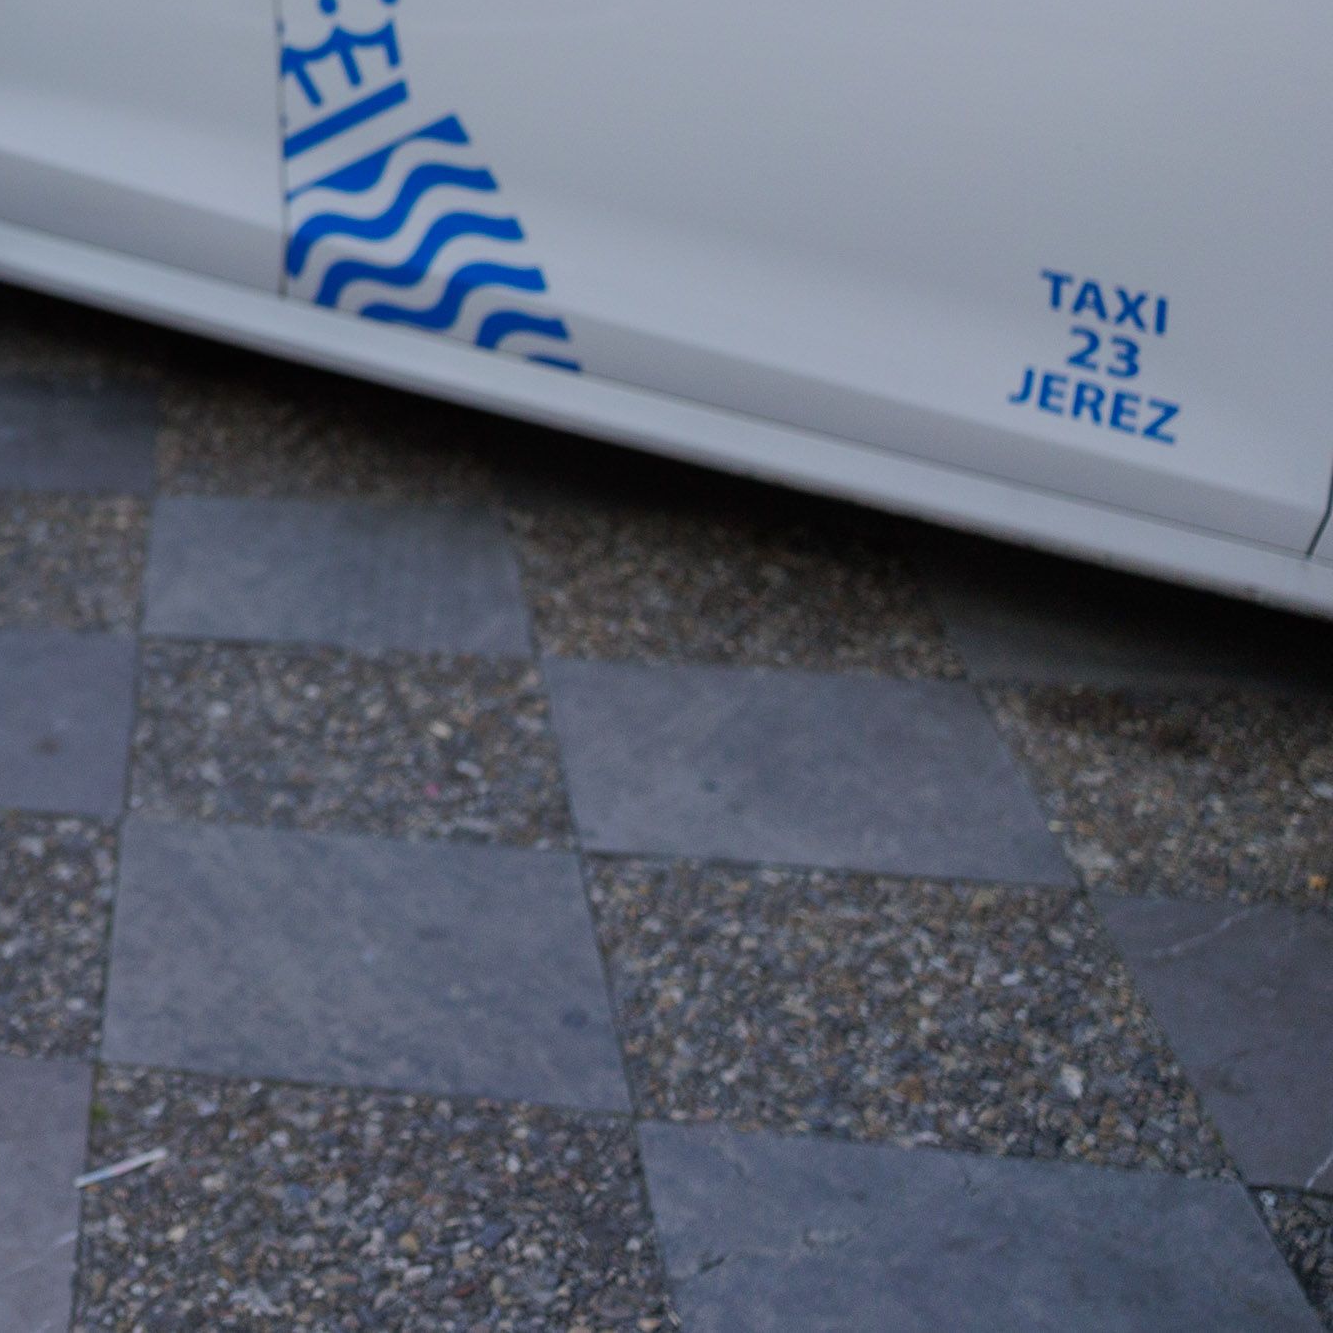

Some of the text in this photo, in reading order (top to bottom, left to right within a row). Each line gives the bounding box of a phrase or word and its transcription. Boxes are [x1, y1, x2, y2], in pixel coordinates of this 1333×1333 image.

[1040, 269, 1168, 335] TAXI
[1067, 325, 1141, 379] 23
[1008, 367, 1180, 444] JEREZ
